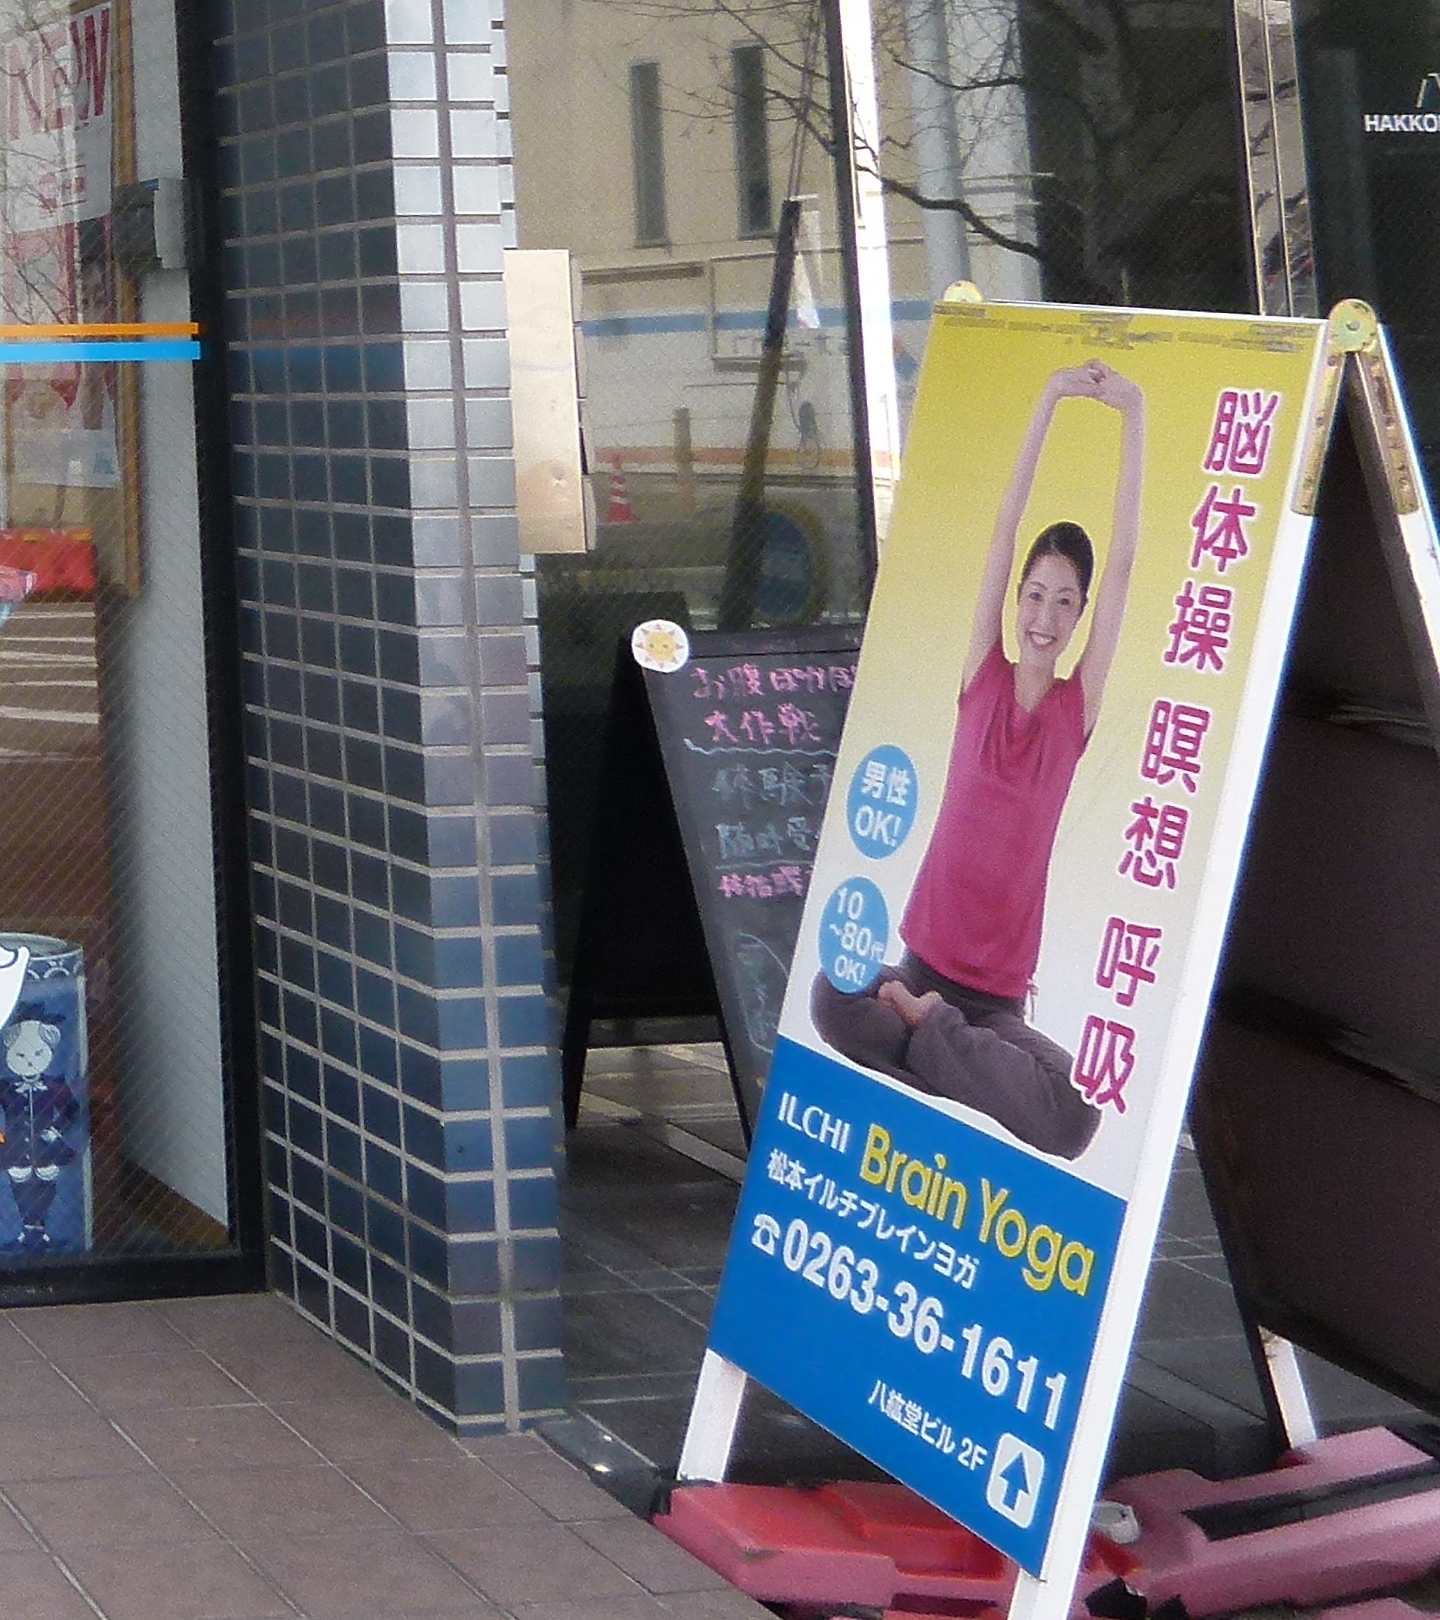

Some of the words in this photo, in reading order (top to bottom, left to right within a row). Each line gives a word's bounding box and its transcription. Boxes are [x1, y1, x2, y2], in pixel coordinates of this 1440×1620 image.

[1163, 390, 1279, 671] 脳体操
[854, 804, 903, 848] OK!
[861, 759, 911, 808] 男性
[1118, 699, 1211, 890] 瞑想
[833, 954, 867, 987] OK!
[837, 887, 864, 921] 10
[1073, 916, 1163, 1115] 呼吸
[766, 1149, 981, 1291] 松本イルチブレインヨガ
[777, 1091, 851, 1153] ILCHI
[858, 1123, 969, 1230] Brain
[978, 1177, 1096, 1297] Yoga
[783, 1217, 1066, 1430] 0263-36-1611
[958, 1437, 988, 1472] 2F
